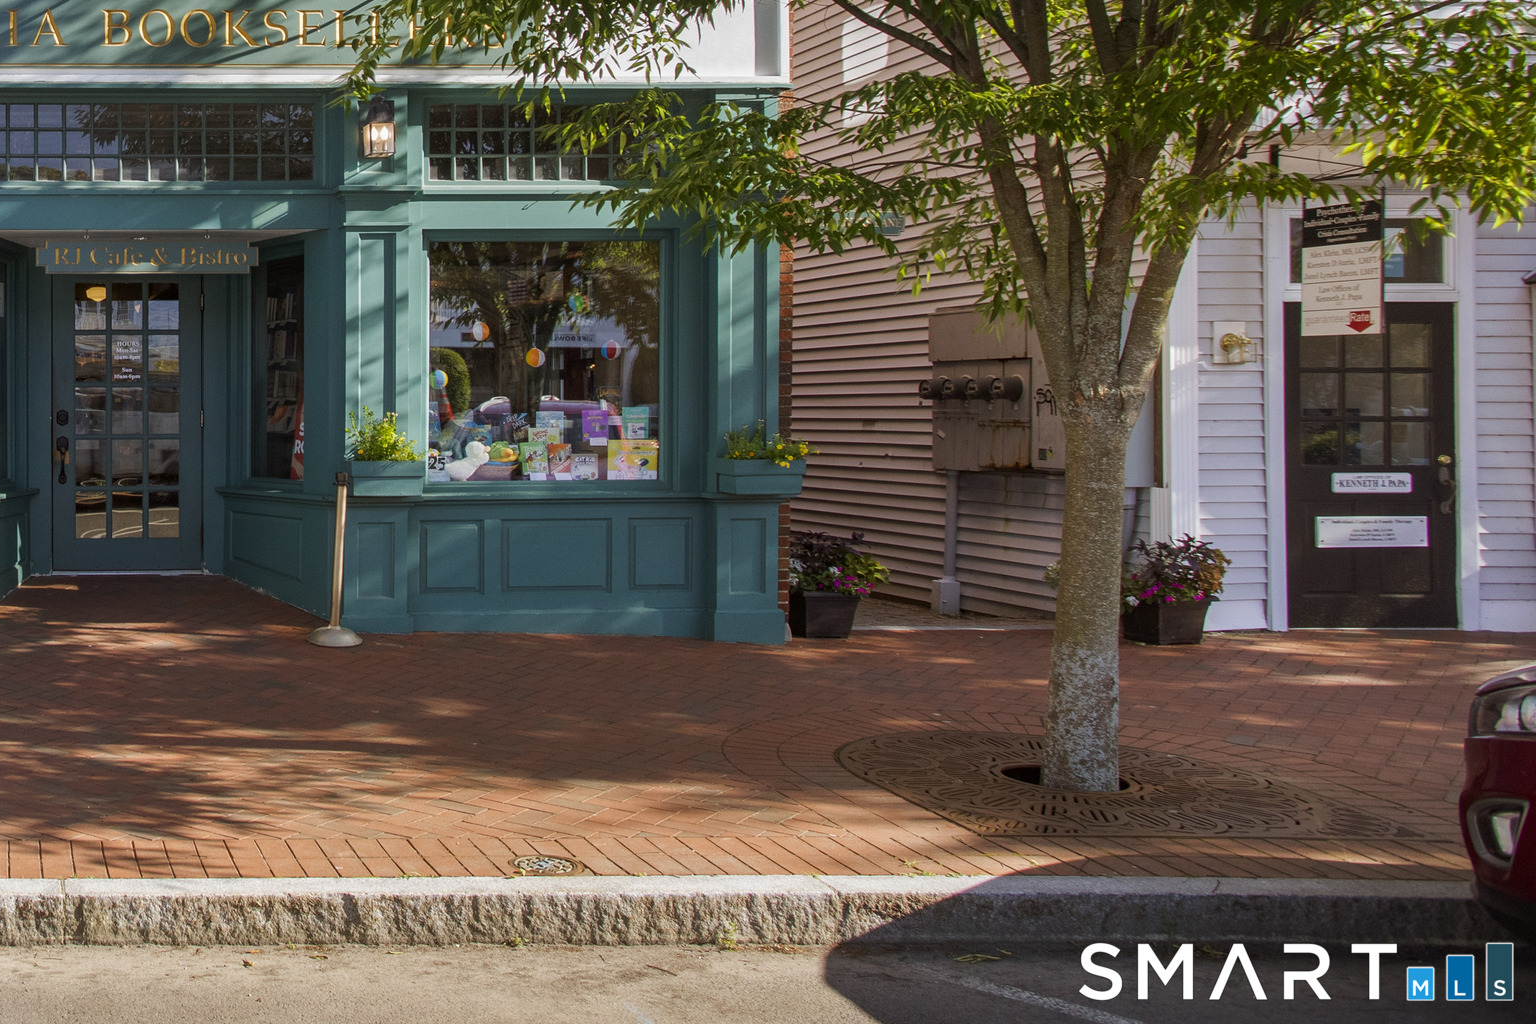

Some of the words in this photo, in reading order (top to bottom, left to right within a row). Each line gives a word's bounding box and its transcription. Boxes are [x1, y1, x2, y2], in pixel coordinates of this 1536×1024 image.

[1317, 204, 1366, 217] Psychothery
[54, 247, 81, 265] RJ
[90, 246, 143, 266] Cafe
[150, 247, 170, 266] &
[180, 246, 247, 266] Bistro
[1353, 283, 1360, 291] of
[1350, 313, 1370, 322] Rate
[1339, 479, 1379, 488] KENNETH
[1388, 479, 1407, 488] PAPA
